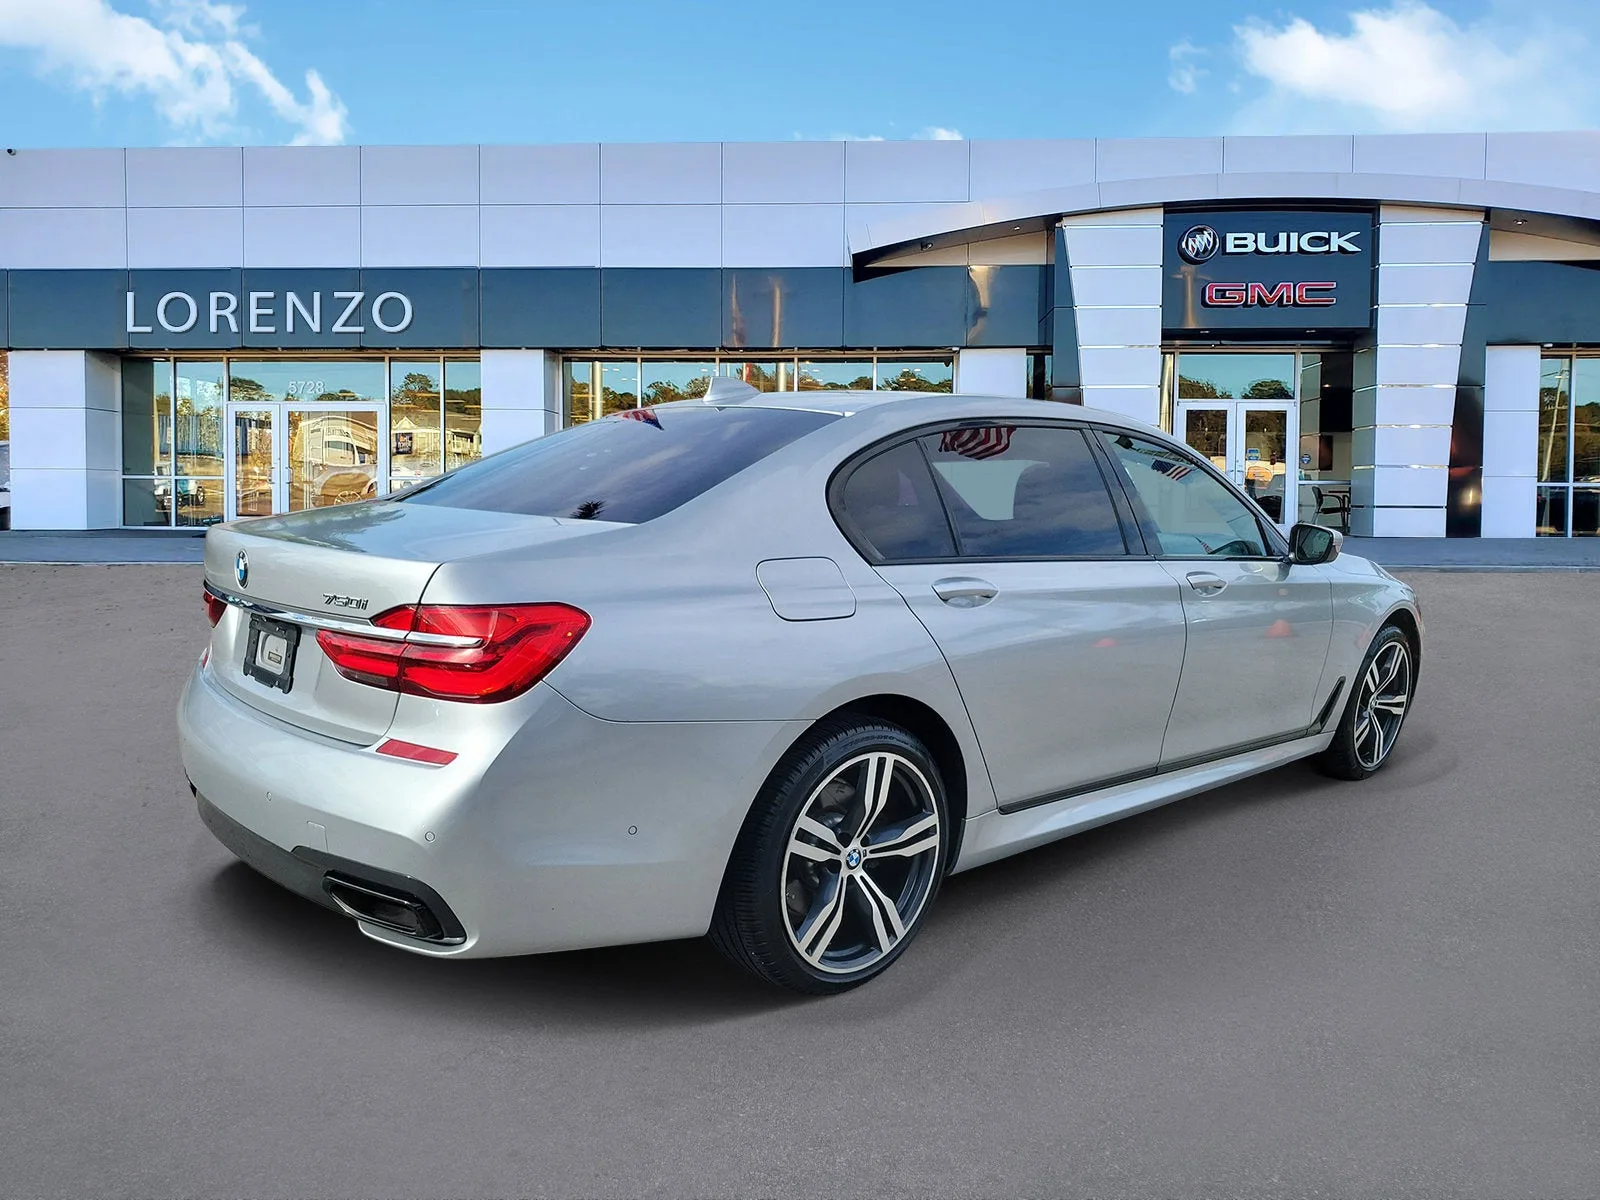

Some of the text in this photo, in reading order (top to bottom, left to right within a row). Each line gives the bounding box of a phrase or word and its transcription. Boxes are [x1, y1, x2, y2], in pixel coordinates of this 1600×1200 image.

[1225, 231, 1362, 253] BUICK
[1206, 282, 1337, 305] GMC
[126, 290, 414, 334] LORENZO
[288, 380, 325, 394] 5728
